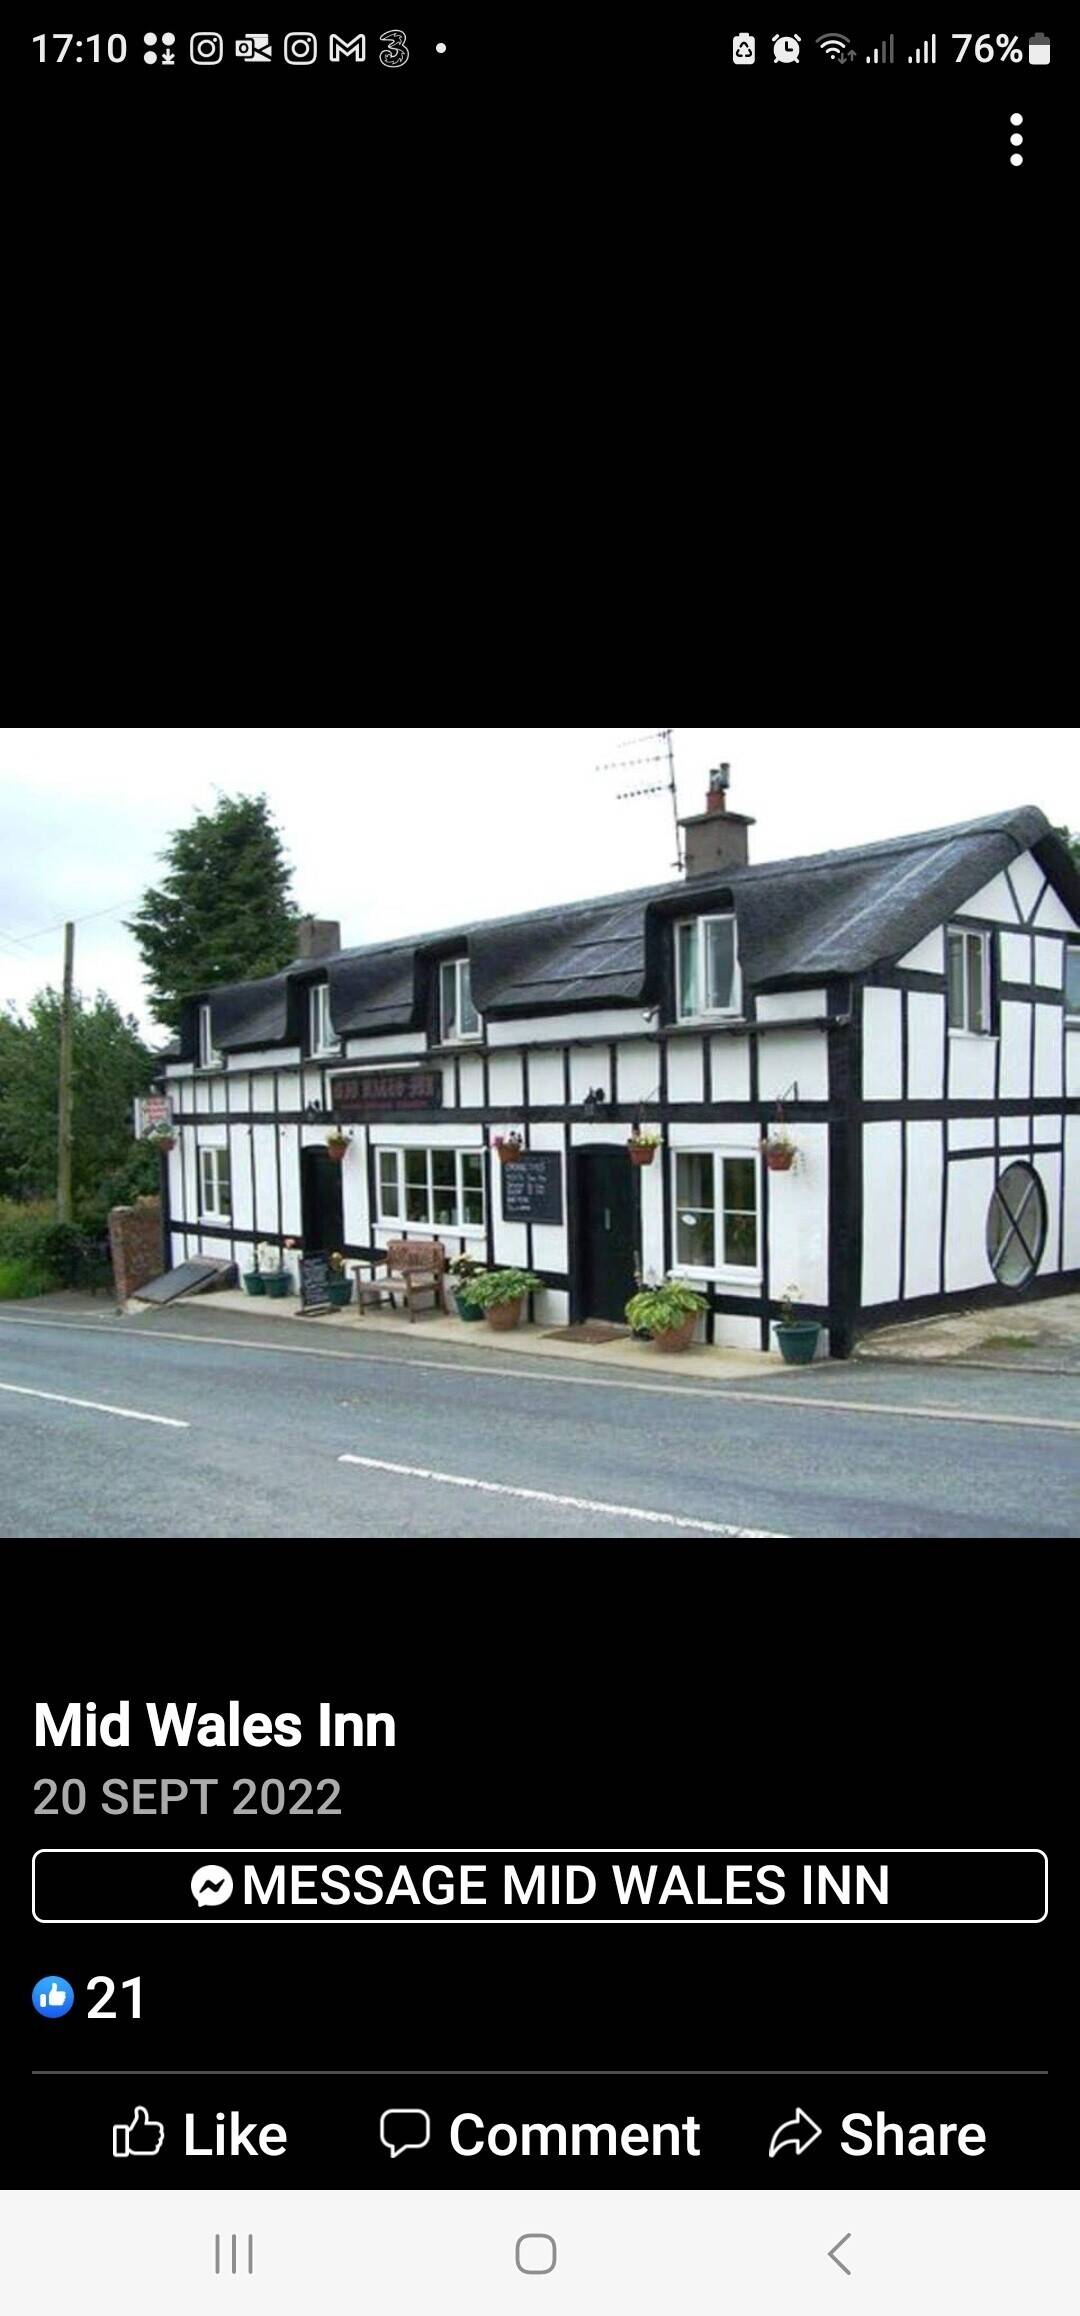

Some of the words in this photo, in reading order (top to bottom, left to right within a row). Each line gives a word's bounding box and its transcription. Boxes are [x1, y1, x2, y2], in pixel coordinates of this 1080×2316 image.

[33, 34, 127, 63] 17:10
[952, 33, 1023, 63] 76%
[35, 1701, 130, 1748] Mid
[146, 1700, 302, 1748] Wales
[320, 1702, 396, 1747] Inn
[34, 1779, 86, 1815] 20
[101, 1779, 219, 1815] SEPT
[232, 1779, 342, 1815] 2022
[244, 1864, 487, 1906] MESSAGE
[504, 1864, 597, 1905] MID
[611, 1864, 786, 1906] WALES
[803, 1864, 889, 1905] INN
[87, 1976, 141, 2018] 21
[185, 2110, 288, 2157] Like
[450, 2112, 701, 2157] Comment
[840, 2110, 987, 2157] Share
